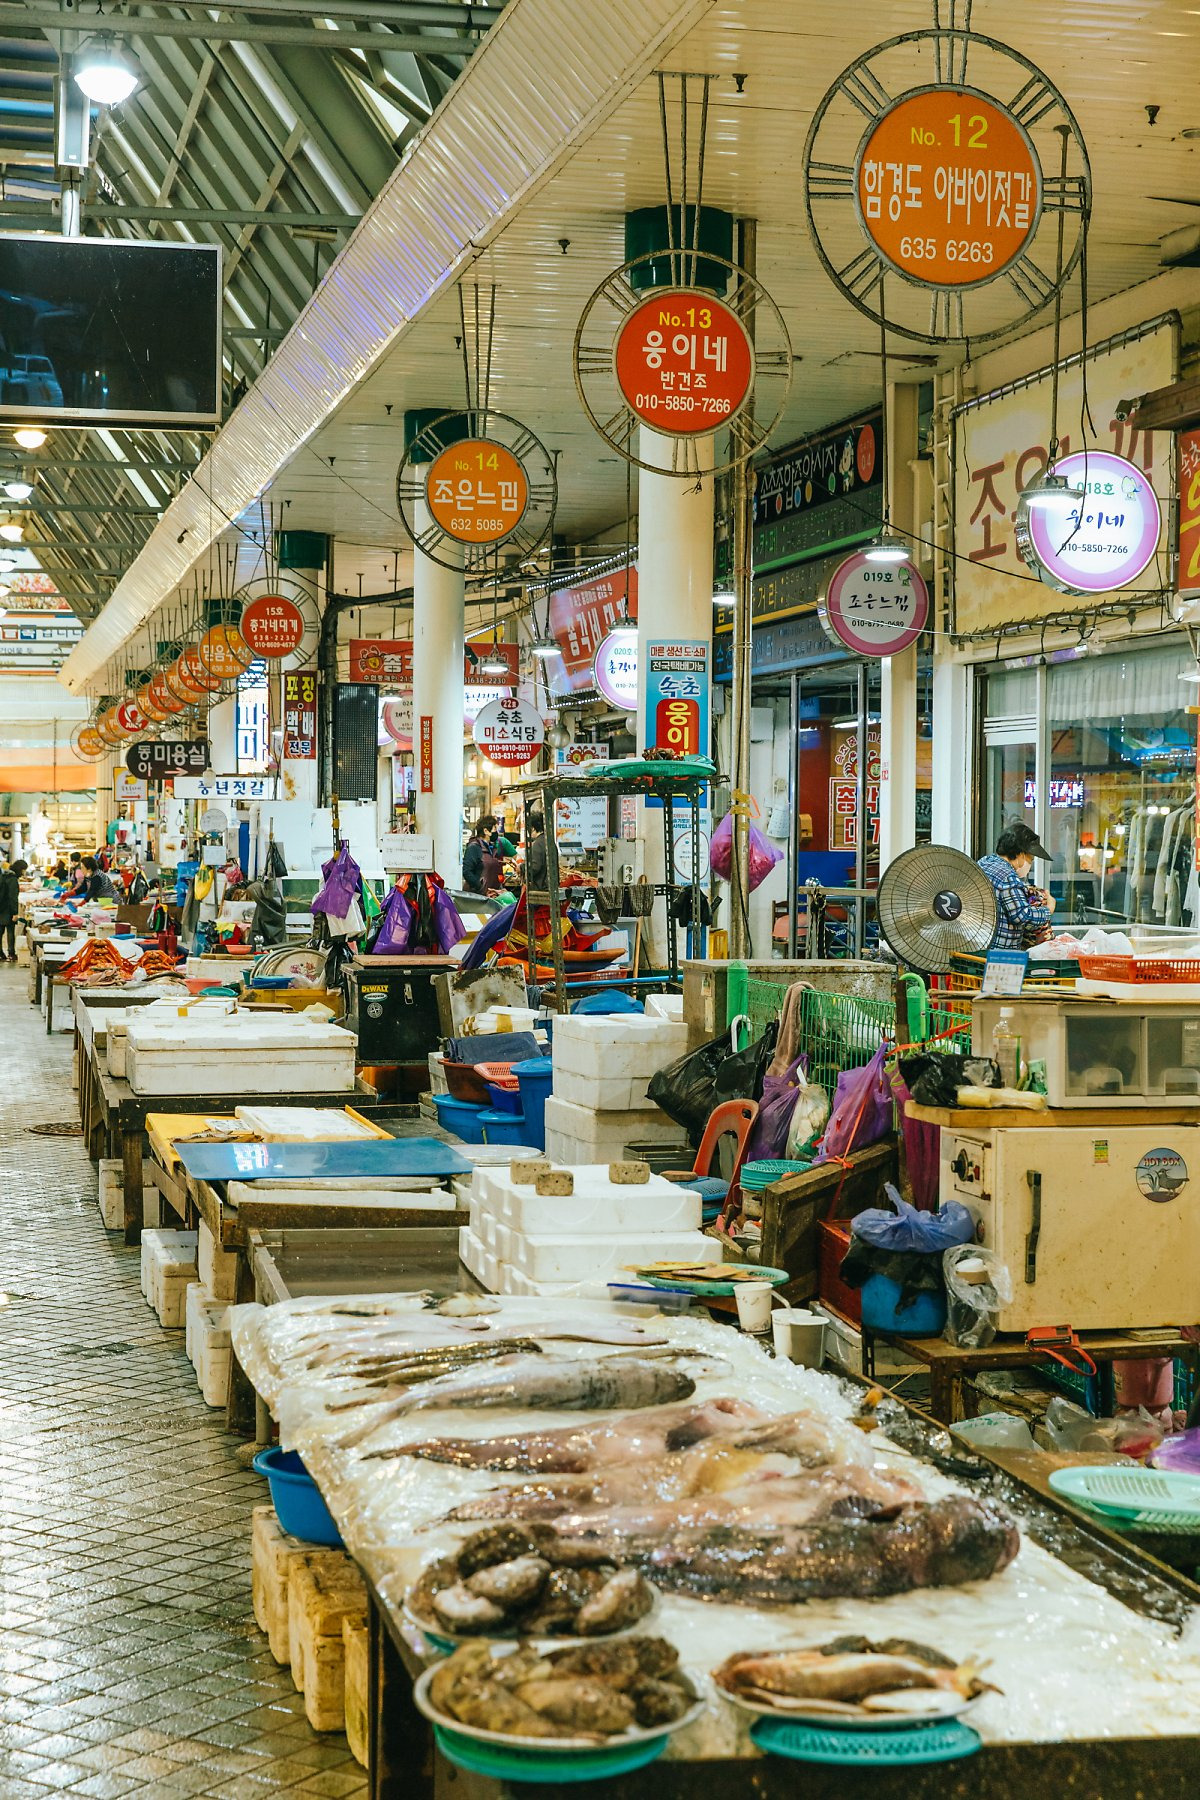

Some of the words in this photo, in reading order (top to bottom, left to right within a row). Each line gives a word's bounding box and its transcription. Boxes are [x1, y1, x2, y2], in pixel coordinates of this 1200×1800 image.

[911, 127, 941, 146] No.
[948, 114, 988, 149] 12
[864, 159, 922, 221] 함경도
[932, 166, 1032, 229] 아바이젓갈
[900, 237, 937, 260] 635
[946, 239, 993, 264] 6263
[642, 330, 727, 372] 웅이네
[660, 371, 707, 391] 반건조
[636, 393, 731, 414] 010-5850-7266
[475, 452, 499, 471] 14
[861, 453, 872, 470] 04
[434, 479, 518, 511] 조은느낌
[451, 518, 471, 530] 632
[476, 519, 504, 531] 5085
[1061, 543, 1128, 554] 010-5850-7266
[863, 572, 894, 583] 019호
[266, 606, 284, 616] 15호
[848, 594, 909, 612] 조은느낌
[650, 646, 664, 657] 마른
[667, 646, 682, 657] 생선
[287, 676, 315, 702] 포장
[661, 677, 700, 697] 속초
[287, 711, 314, 738] 택배
[497, 711, 523, 725] 속초
[484, 727, 537, 741] 미소식당
[665, 702, 692, 756] 웅이
[154, 744, 206, 766] 미용실
[290, 740, 311, 755] 전문
[198, 780, 265, 796] 풍년젓갈
[1144, 1157, 1160, 1166] HOT
[1162, 1157, 1181, 1166] BOX
